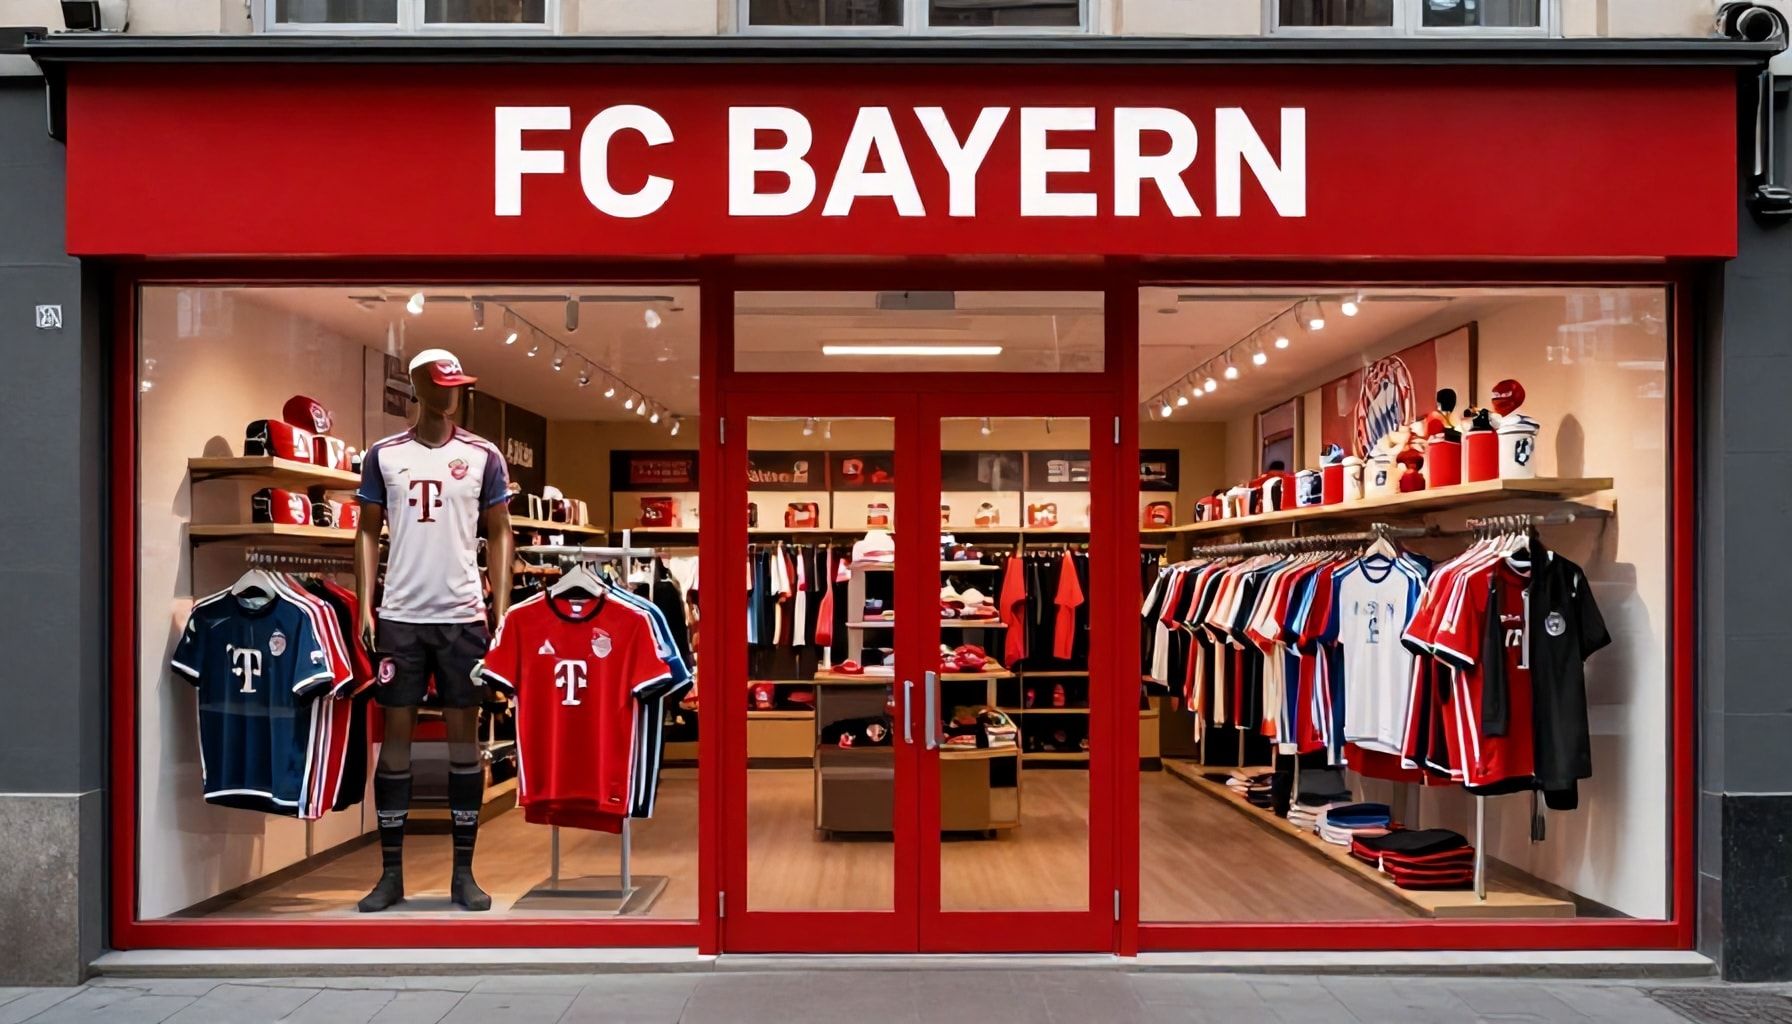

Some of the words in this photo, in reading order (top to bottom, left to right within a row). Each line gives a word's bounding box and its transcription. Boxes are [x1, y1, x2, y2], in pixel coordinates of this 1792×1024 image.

[494, 105, 675, 218] FC
[728, 106, 1307, 218] BAYERN
[409, 480, 443, 523] T
[230, 647, 263, 694] T
[554, 659, 588, 707] T
